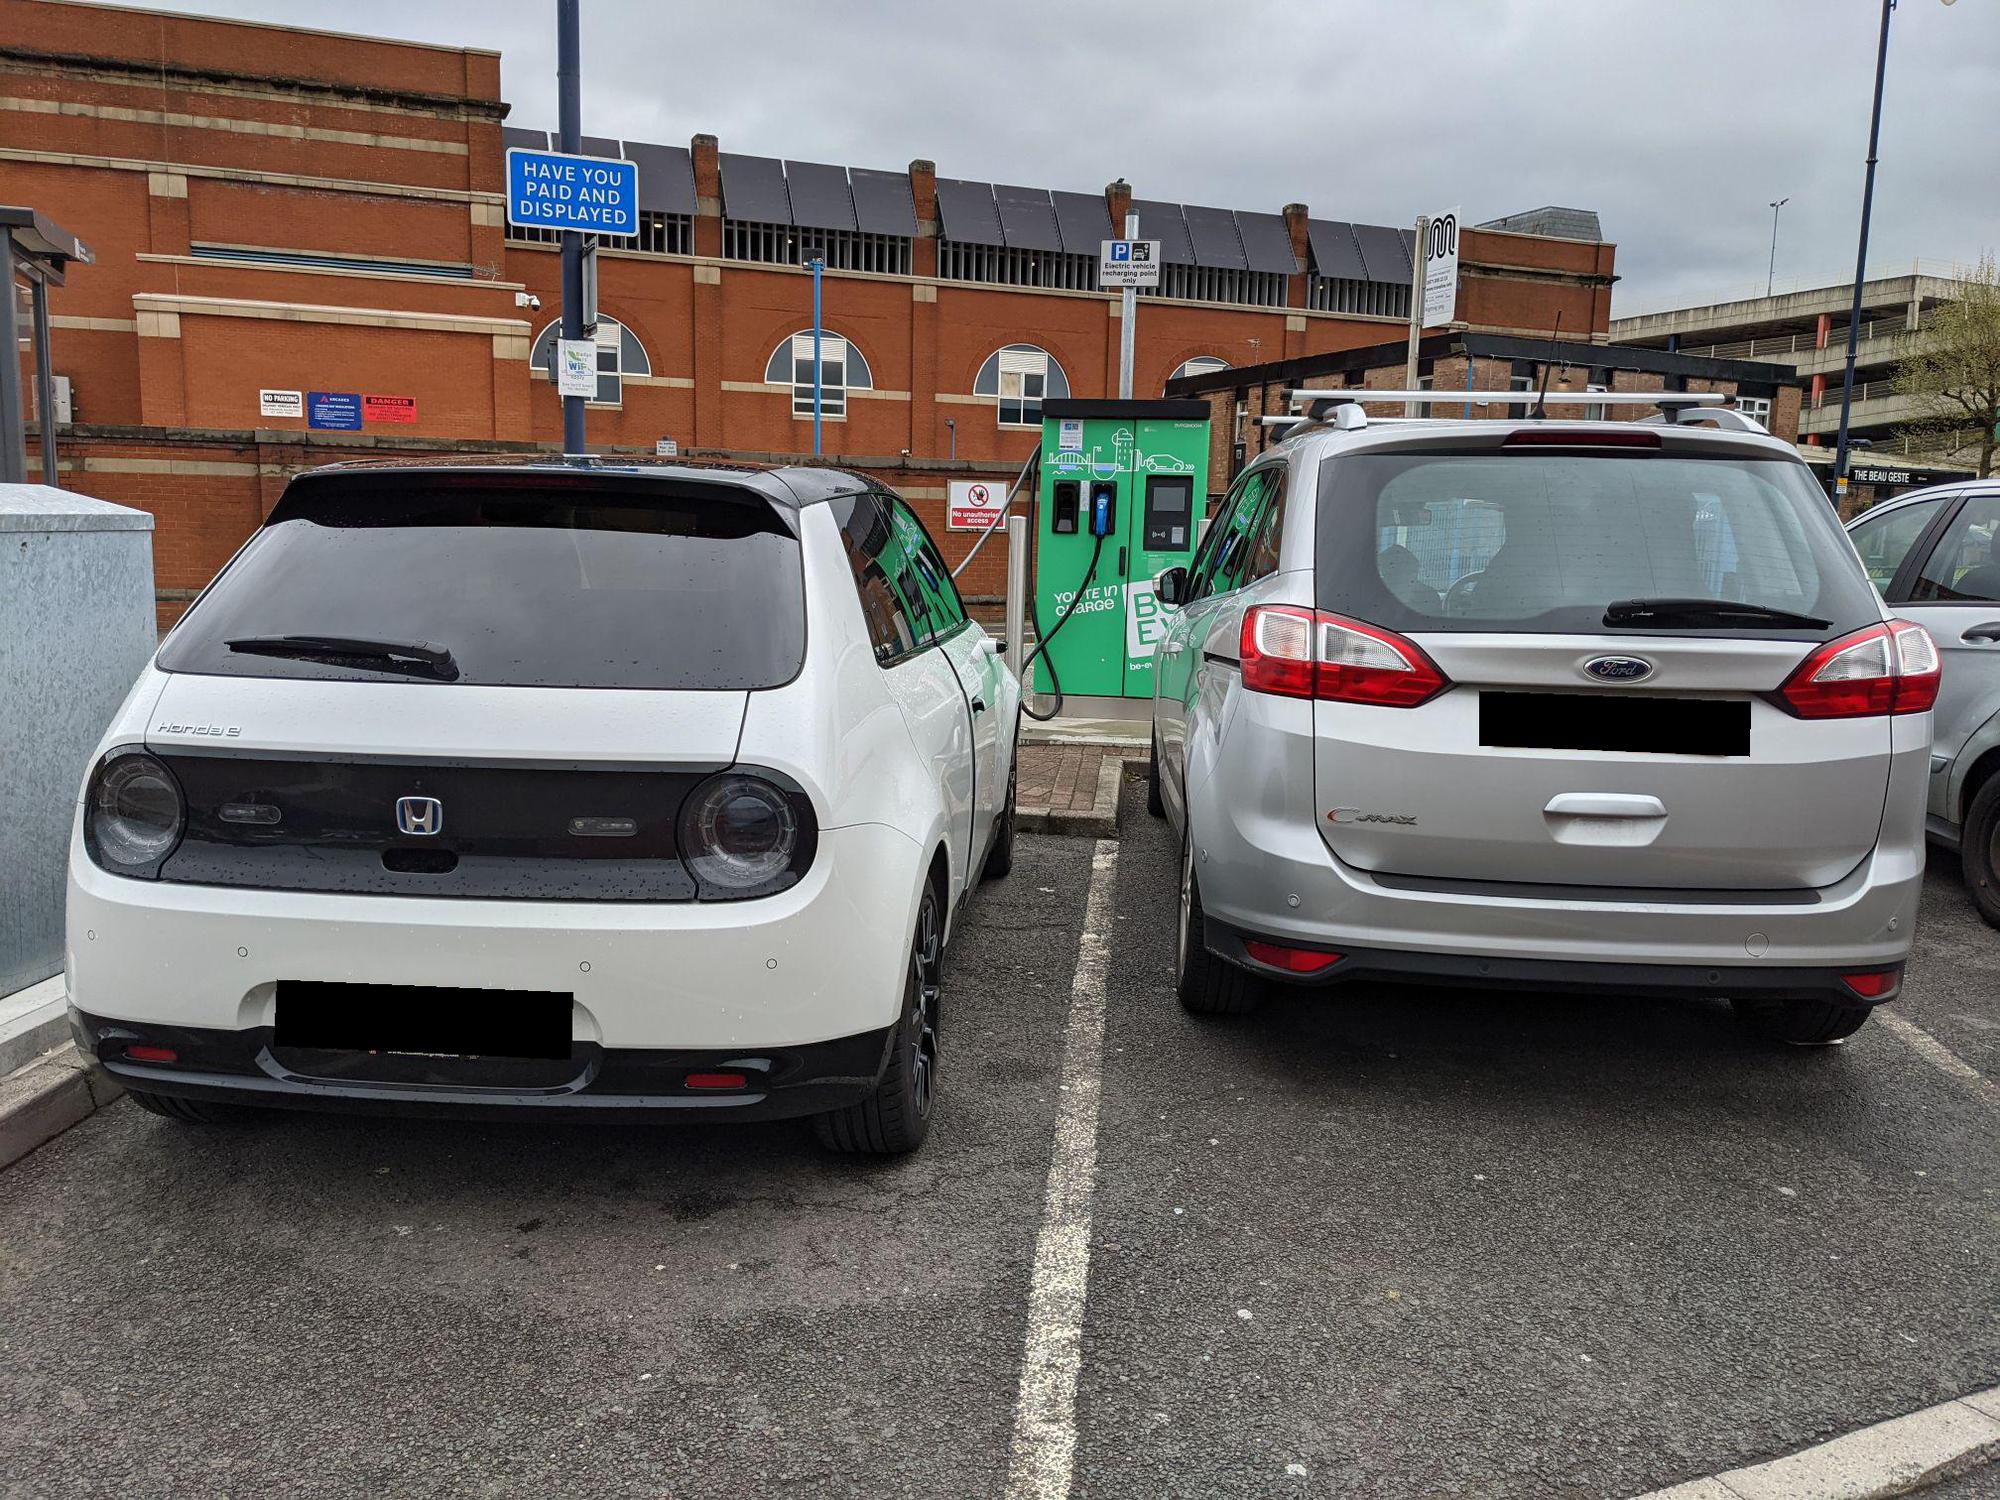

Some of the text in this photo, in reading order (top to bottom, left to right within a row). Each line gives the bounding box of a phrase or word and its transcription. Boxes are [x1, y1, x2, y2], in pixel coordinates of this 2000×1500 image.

[524, 161, 621, 187] HAVE YOU
[526, 181, 620, 206] PAID AND
[520, 200, 627, 225] DISPLAYED
[1102, 270, 1138, 278] recharging
[263, 394, 300, 404] NO PARKING
[370, 398, 409, 406] DANGER
[1854, 469, 1868, 481] THE
[1868, 470, 1888, 483] BEAU
[1888, 472, 1911, 484] GESTE
[952, 510, 962, 518] No
[158, 721, 241, 737] Honda e
